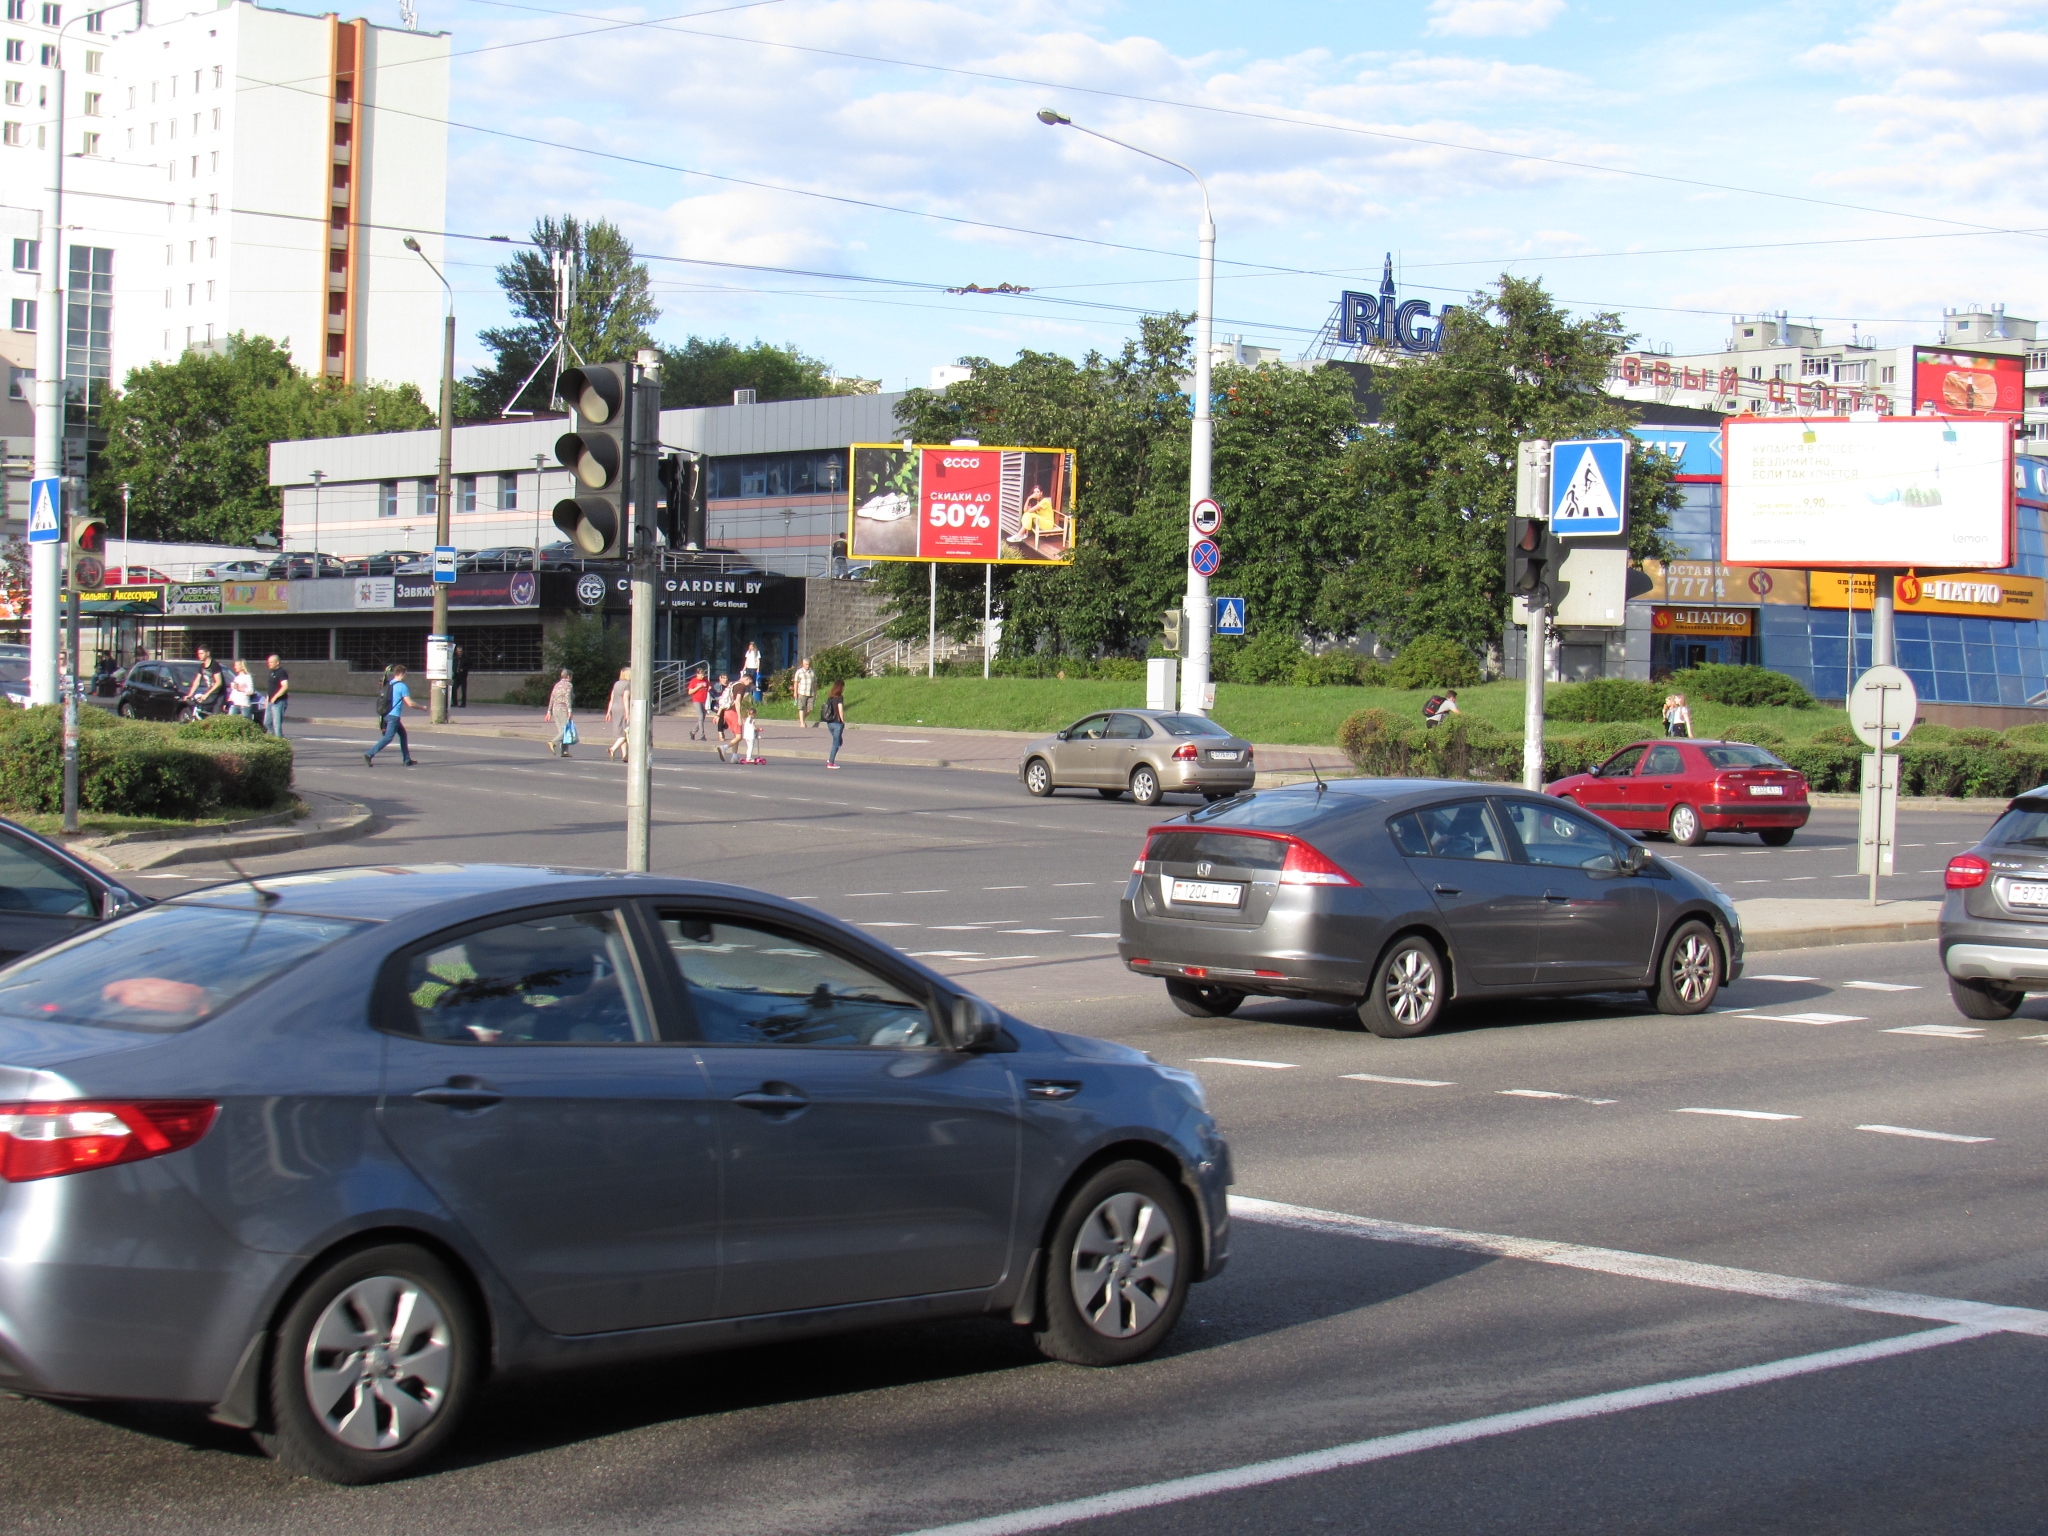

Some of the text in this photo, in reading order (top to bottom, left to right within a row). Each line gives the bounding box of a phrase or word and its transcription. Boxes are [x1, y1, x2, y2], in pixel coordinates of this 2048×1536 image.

[1621, 356, 1739, 397] ОВЫЙ
[942, 457, 980, 469] ecco
[1752, 456, 1832, 468] БЕЗЛИМИТНО,
[1752, 469, 1859, 480] ЕСЛИ ТАК ХОЧЕТСЯ
[930, 491, 992, 502] СКИДКИ ДО
[929, 503, 991, 529] 50%
[1750, 538, 1807, 546] lemon.velcom.by
[1952, 533, 1989, 544] lemon
[1666, 577, 1726, 598] 7774
[1934, 580, 2001, 604] ПАТИО
[113, 590, 158, 602] Аксессуары
[227, 585, 288, 604] ИГРУШКИ
[1686, 611, 1747, 625] ПАТИО
[1185, 884, 1207, 899] 1204
